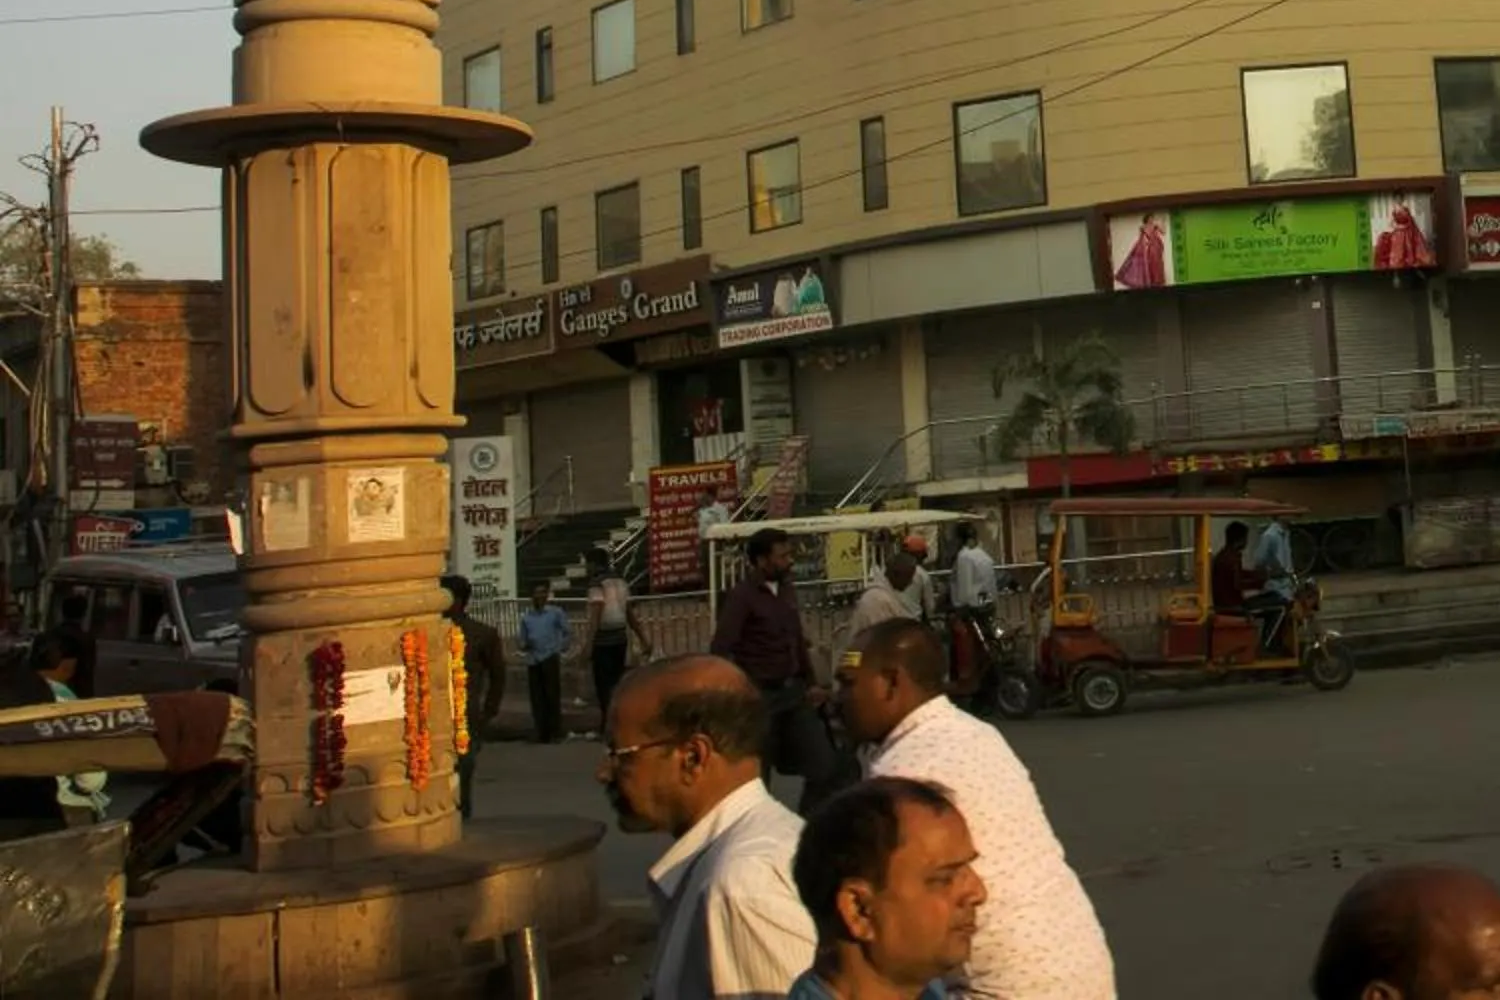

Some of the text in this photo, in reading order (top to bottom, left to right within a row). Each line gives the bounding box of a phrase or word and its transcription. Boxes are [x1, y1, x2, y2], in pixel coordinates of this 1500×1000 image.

[1287, 231, 1340, 248] Factory
[727, 281, 760, 304] Amul
[561, 303, 628, 337] Ganges
[633, 280, 699, 320] Grand
[461, 475, 508, 498] होटल
[656, 471, 729, 489] TRAVELS
